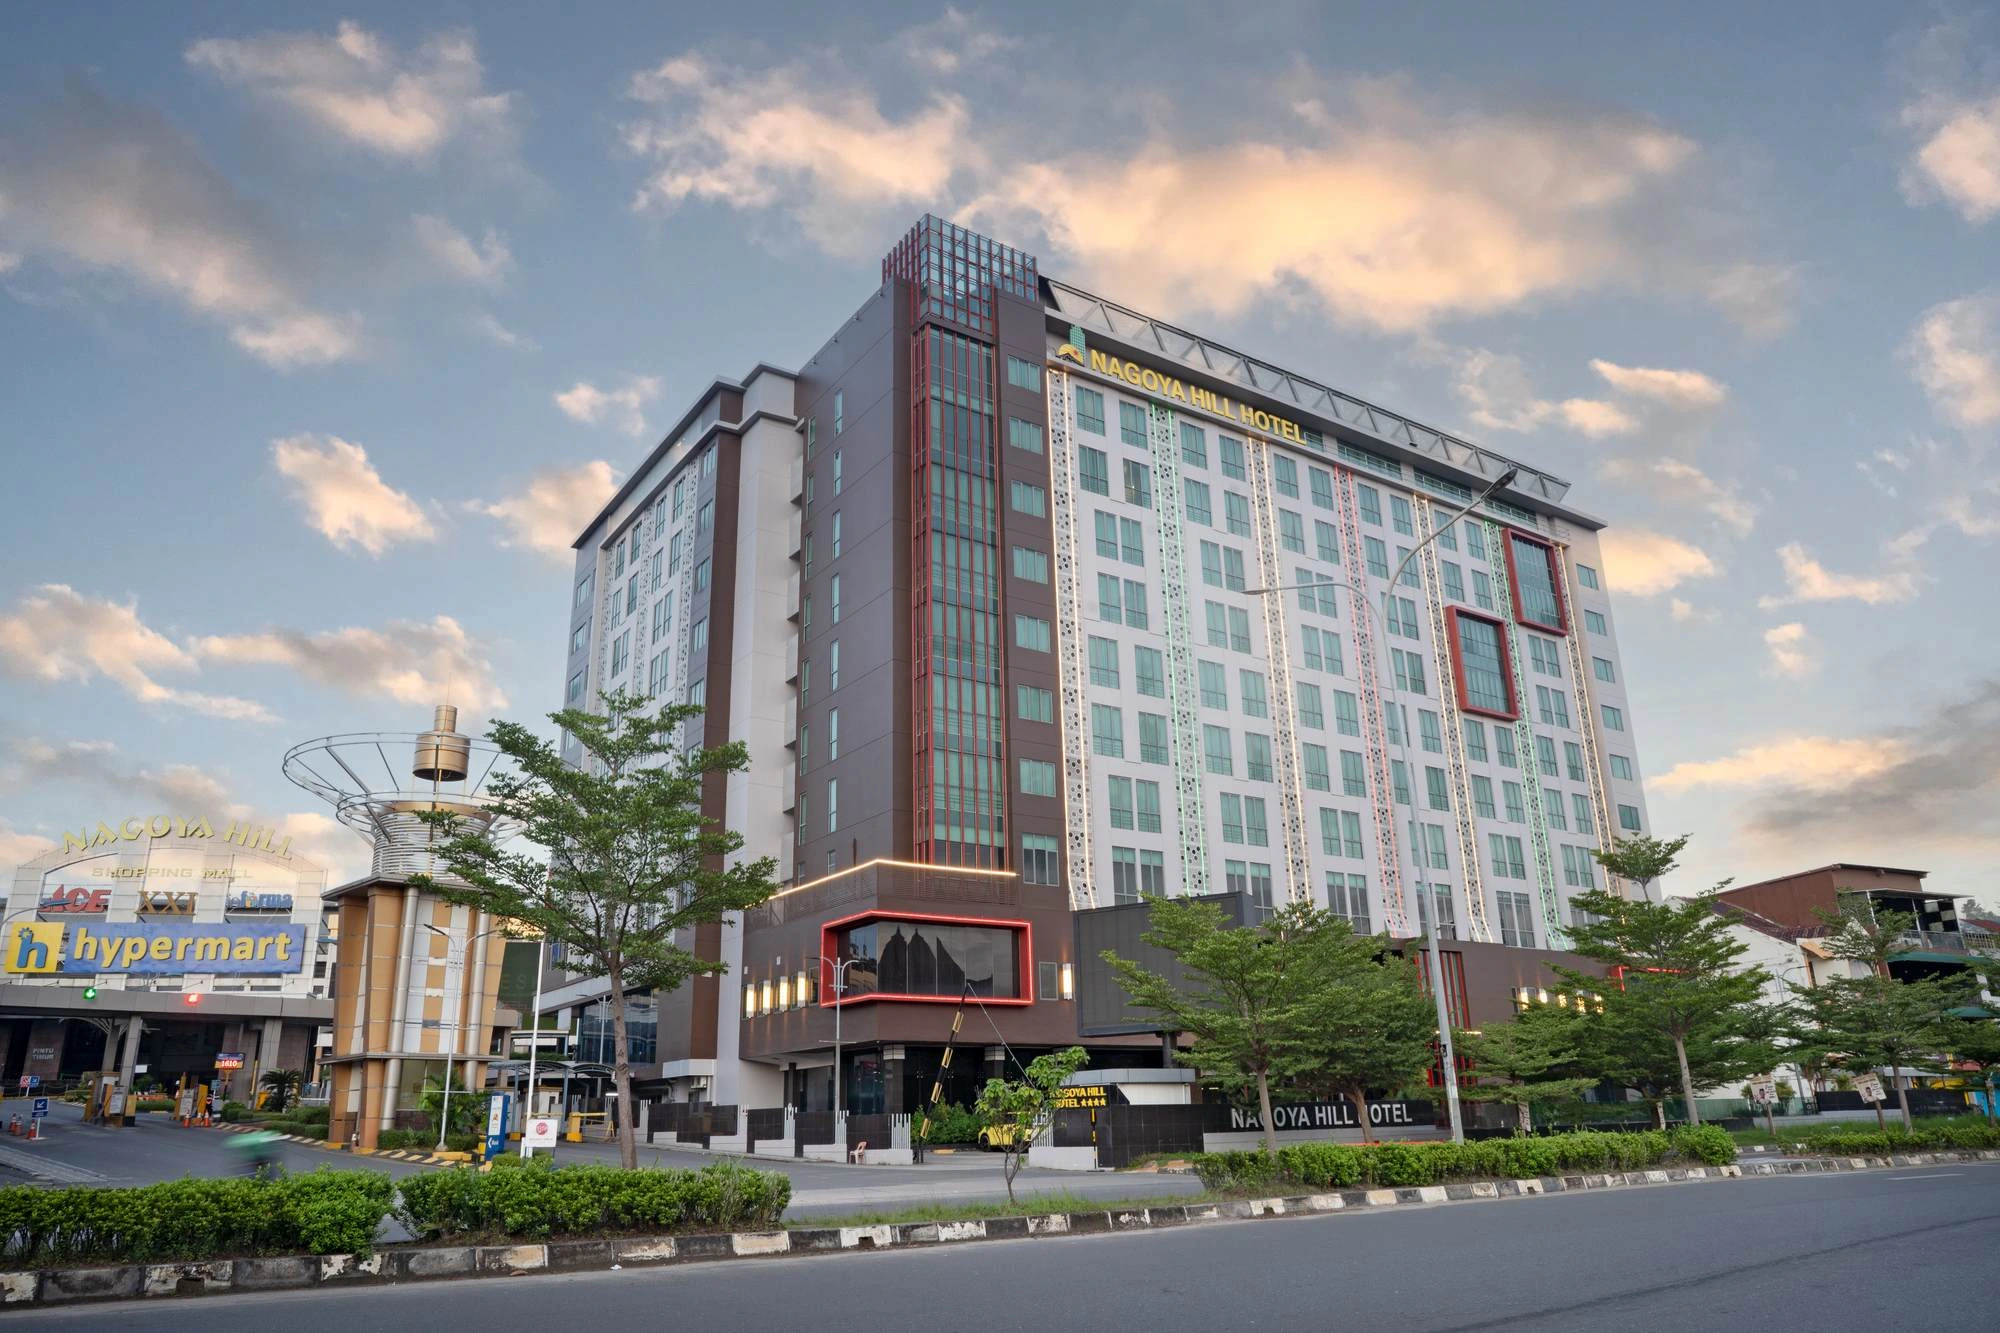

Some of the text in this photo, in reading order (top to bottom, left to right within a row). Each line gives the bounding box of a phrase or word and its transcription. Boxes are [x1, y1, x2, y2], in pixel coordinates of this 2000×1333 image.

[1090, 349, 1308, 445] NAGOYA HILL HOTEL
[62, 815, 215, 854] NAGOYA
[91, 867, 253, 879] SHOPPING MALL
[38, 884, 112, 913] ACE
[135, 890, 198, 916] XXI
[73, 927, 291, 968] hypermart
[1087, 1086, 1106, 1096] HILL
[1315, 1105, 1354, 1126] HILL
[1358, 1103, 1412, 1124] OTEL
